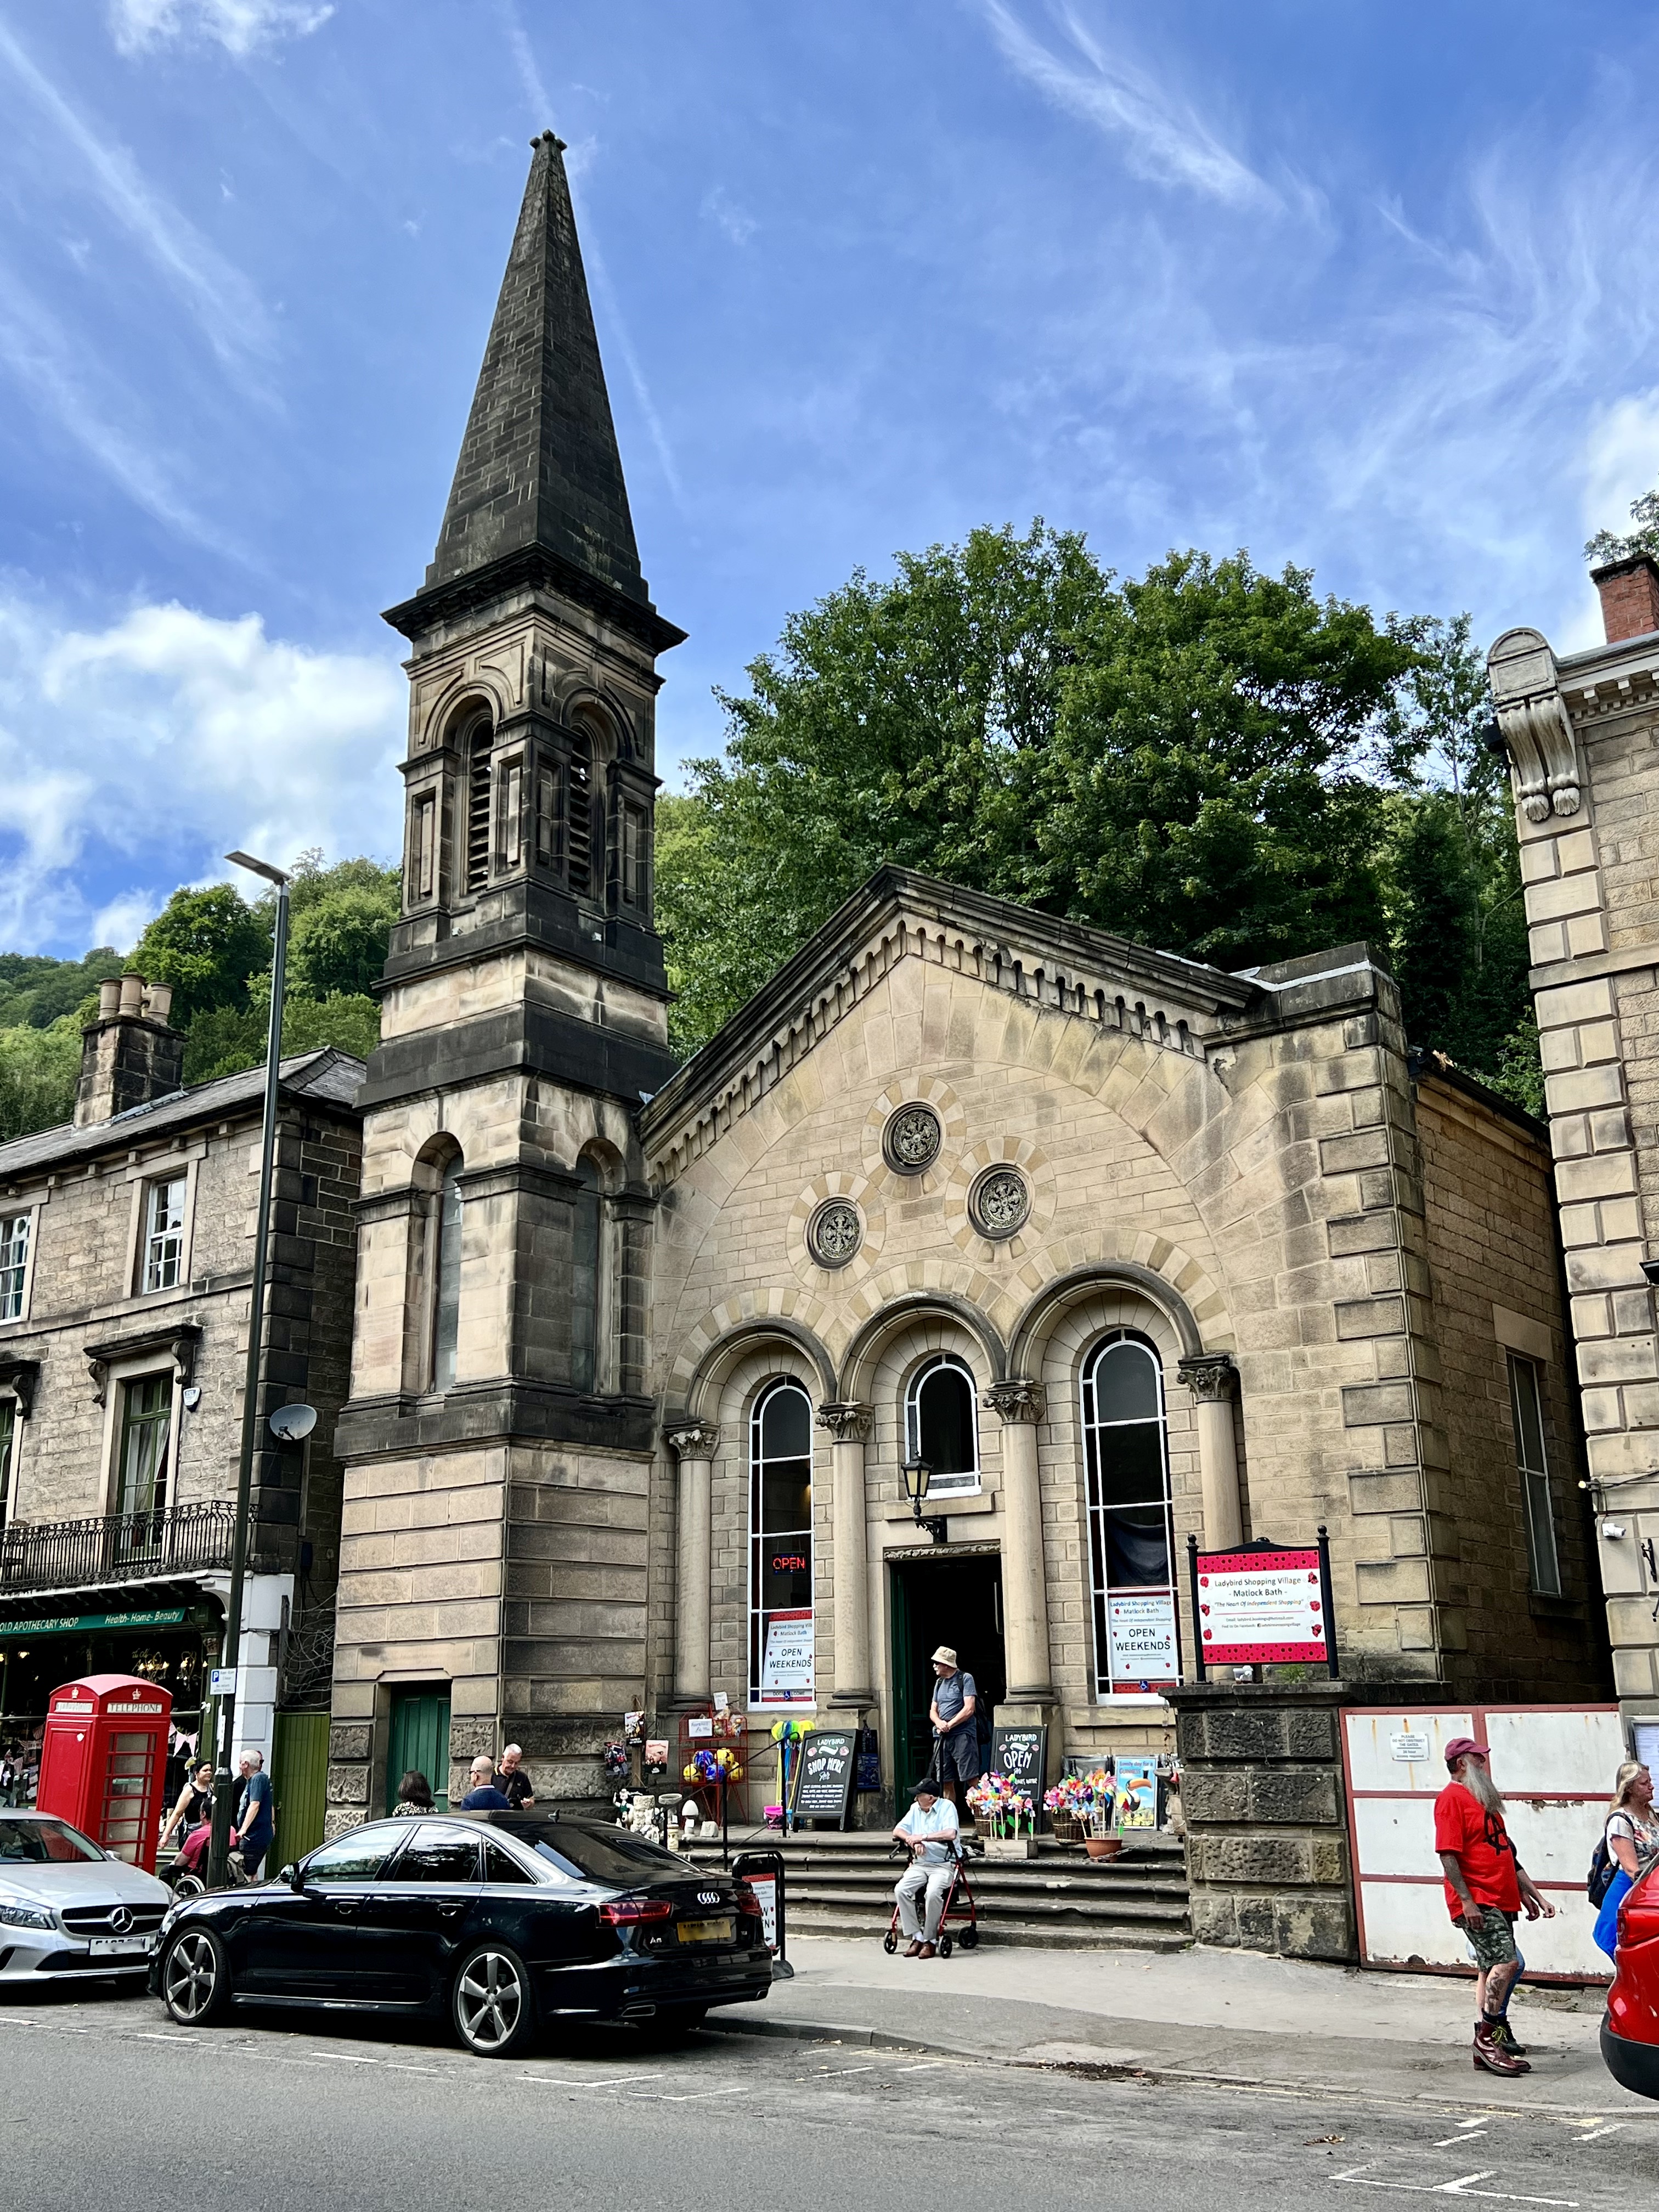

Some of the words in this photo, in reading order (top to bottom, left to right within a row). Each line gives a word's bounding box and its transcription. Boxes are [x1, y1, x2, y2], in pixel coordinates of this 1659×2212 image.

[773, 1557, 805, 1569] OPEN
[1215, 1579, 1243, 1587] Ladybird
[1277, 1577, 1301, 1585] Village
[0, 1622, 13, 1632] OLD
[13, 1618, 59, 1631] APOTHECARY
[59, 1617, 79, 1628] SHOP
[154, 1611, 180, 1621] Beauty
[1129, 1628, 1155, 1637] OPEN
[1116, 1641, 1170, 1651] WEEKENDS
[782, 1648, 802, 1656] OPEN
[769, 1659, 812, 1668] WEEKENDS
[111, 1703, 160, 1712] TELEPHONE
[1003, 1751, 1032, 1769] OPEN
[808, 1758, 826, 1775] SHOP
[827, 1757, 845, 1774] HERE
